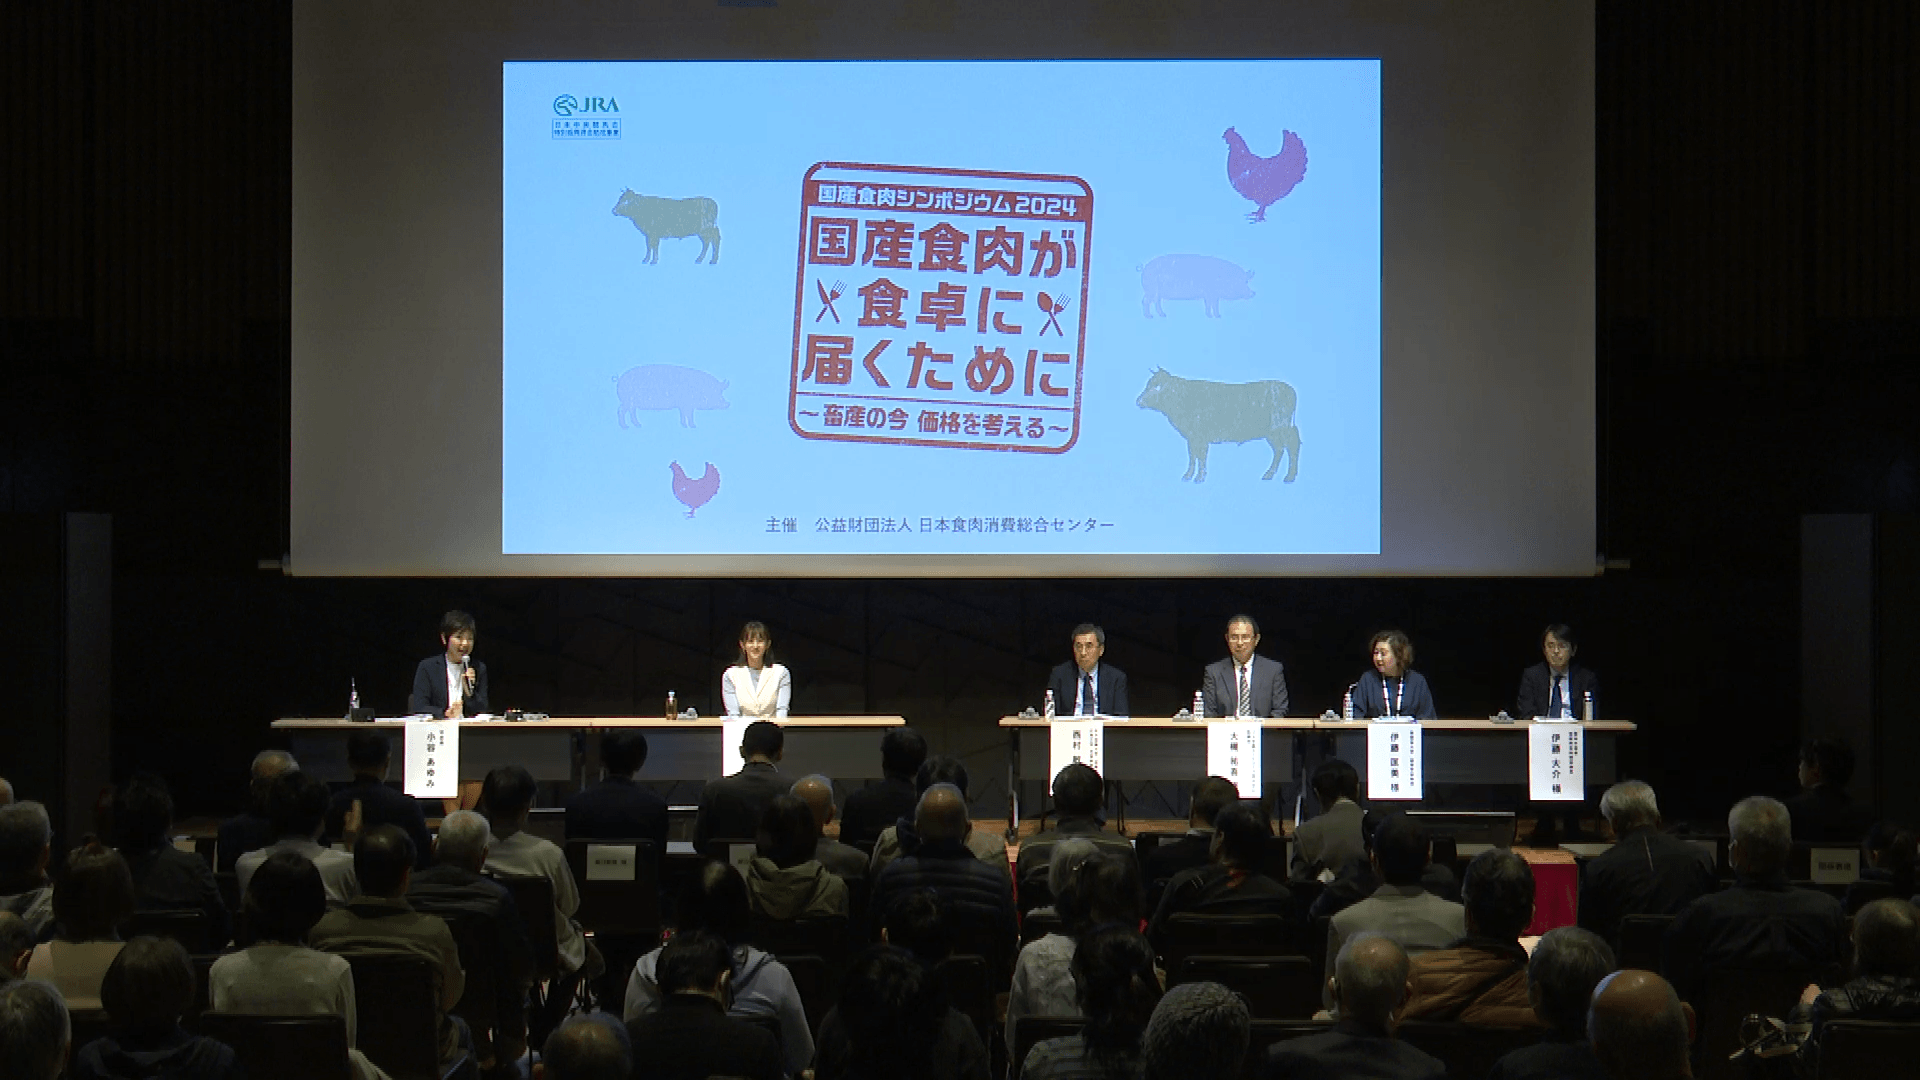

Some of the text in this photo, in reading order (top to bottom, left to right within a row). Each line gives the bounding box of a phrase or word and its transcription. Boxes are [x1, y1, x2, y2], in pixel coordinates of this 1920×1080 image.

[578, 96, 620, 112] JRA
[817, 184, 1077, 217] 国産食肉シンポジウム 2024
[808, 215, 1078, 278] 国産食肉が
[857, 277, 1024, 335] 食卓に
[801, 333, 1071, 397] 届くために
[765, 516, 1115, 533] 主催 公益財団法人 日本食肉消費総合センター
[1551, 759, 1561, 780] 大介
